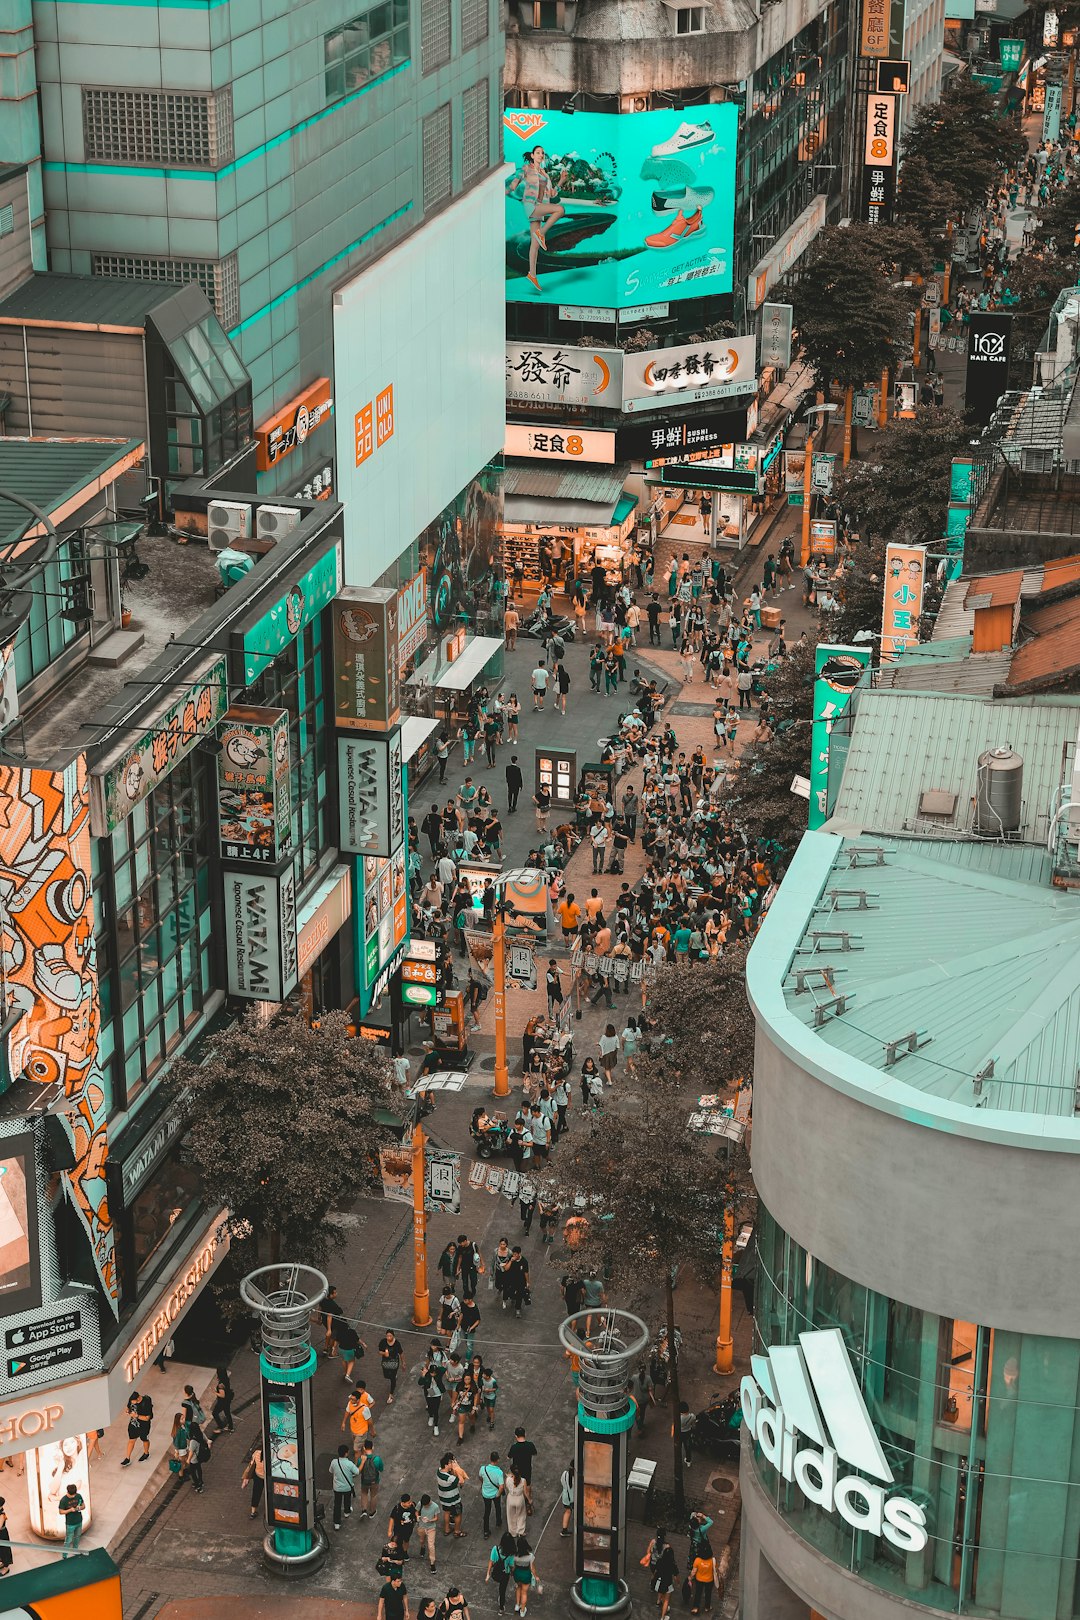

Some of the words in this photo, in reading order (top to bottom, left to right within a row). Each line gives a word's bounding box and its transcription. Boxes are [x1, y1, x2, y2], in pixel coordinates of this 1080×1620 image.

[510, 113, 542, 126] PONY
[871, 103, 887, 158] 定食8
[378, 392, 391, 418] UNI
[508, 390, 529, 399] 2388
[530, 392, 551, 400] 6611
[357, 409, 371, 437] ユニ
[379, 413, 393, 442] QLO
[687, 428, 708, 438] SUSHI
[357, 432, 372, 460] クロ
[533, 433, 584, 455] 定食8
[687, 433, 718, 444] EXPRESS
[346, 745, 356, 780] Japanese
[348, 781, 357, 806] Casual
[358, 747, 379, 849] WATAMI
[226, 845, 270, 861] 請上4F
[233, 881, 243, 919] Japanese
[235, 919, 245, 948] Casual
[246, 884, 270, 994] WATAMI
[236, 948, 247, 991] Restaurant
[129, 1129, 165, 1186] WATAMI
[29, 1319, 56, 1331] Download
[29, 1329, 49, 1340] App
[50, 1322, 75, 1335] Store
[124, 1331, 153, 1382] THE
[152, 1283, 187, 1345] FACE
[30, 1351, 56, 1363] Google
[56, 1347, 72, 1355] Play
[740, 1376, 928, 1552] adidas
